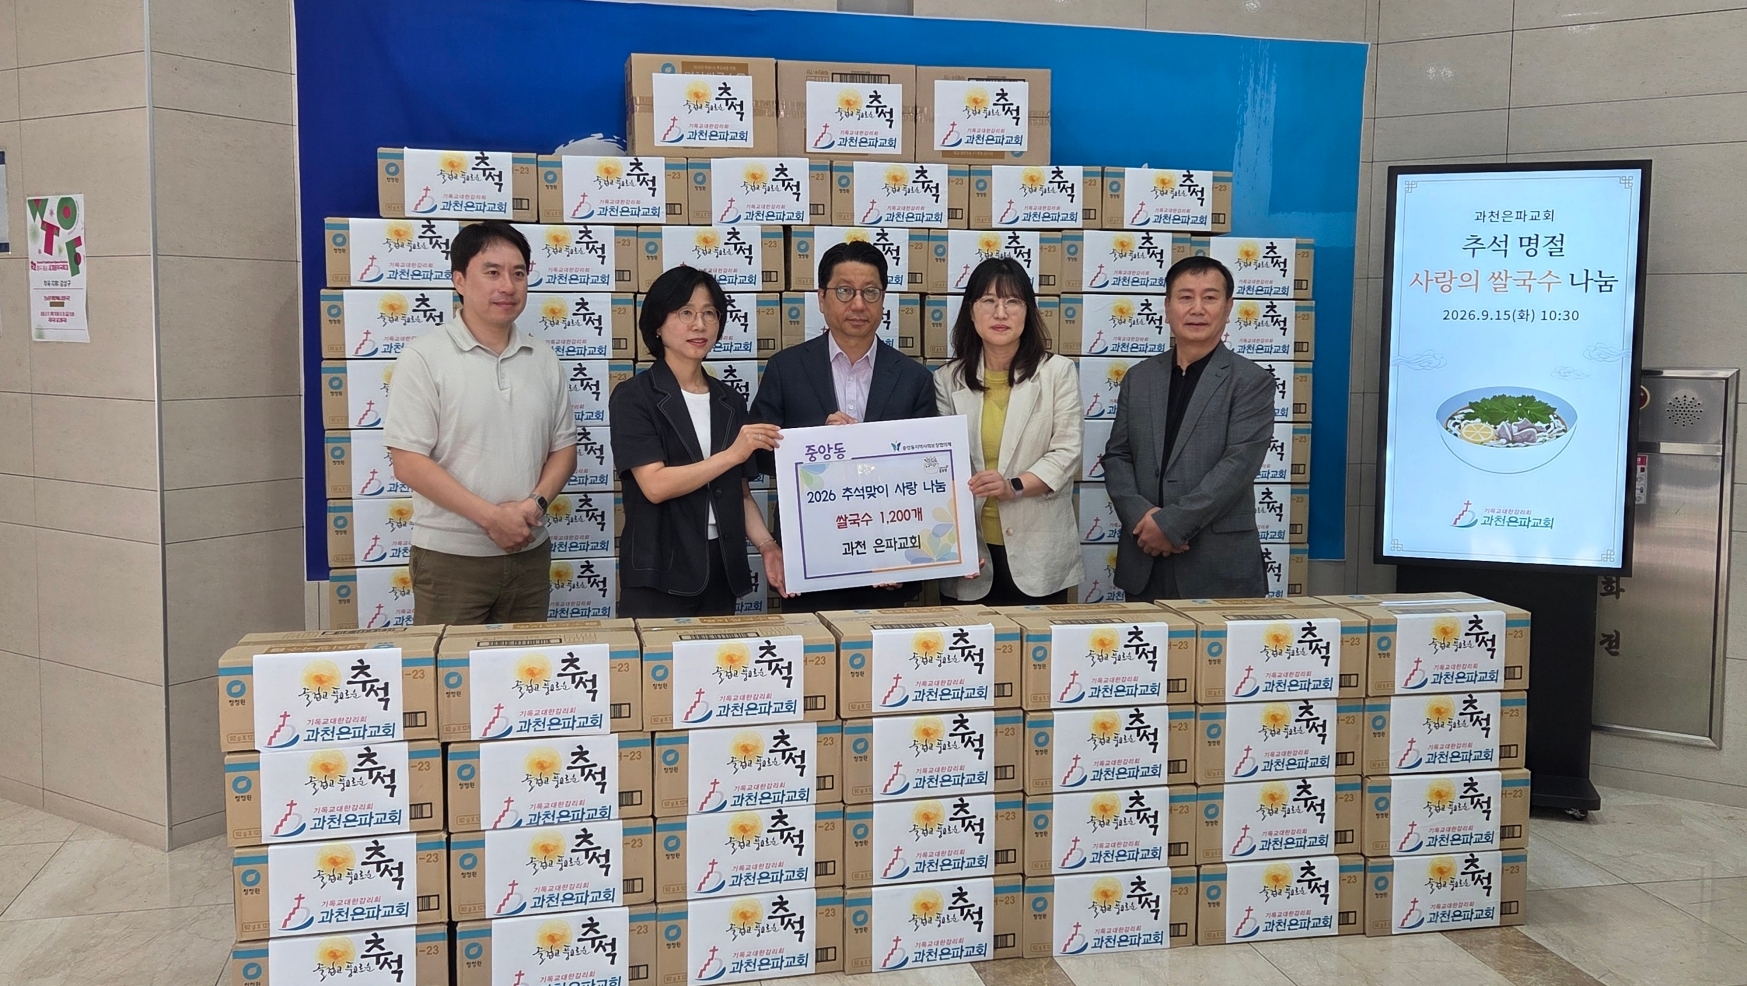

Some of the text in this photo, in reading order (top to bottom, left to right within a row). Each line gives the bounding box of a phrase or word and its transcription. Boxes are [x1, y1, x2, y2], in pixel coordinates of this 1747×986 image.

[716, 82, 744, 121] 추석
[866, 90, 893, 128] 추석
[993, 88, 1020, 126] 추석
[686, 131, 748, 142] 과천은파교회
[837, 138, 896, 148] 과천은파교회
[964, 135, 1022, 145] 과천은파교회
[472, 154, 503, 192] 추석
[627, 158, 656, 197] 추석
[772, 163, 800, 201] 추석
[913, 166, 939, 203] 추석
[1049, 168, 1074, 202] 추석
[1179, 172, 1204, 206] 추석
[440, 200, 507, 211] 과천은파교회
[597, 205, 660, 216] 과천은파교회
[744, 210, 804, 220] 과천은파교회
[1474, 209, 1555, 223] 과천은파교회
[884, 211, 942, 222] 과천은파교회
[1021, 211, 1077, 222] 과천은파교회
[1152, 213, 1207, 223] 과천은파교회
[418, 220, 450, 260] 추석
[576, 228, 605, 264] 추석
[1139, 234, 1163, 267] 추석
[1462, 233, 1565, 258] 추석 명절
[1263, 242, 1287, 277] 추석
[545, 272, 609, 284] 과천은파교회
[1110, 275, 1164, 286] 과천은파교회
[1409, 269, 1619, 293] 사랑의 쌀국수 나눔
[1237, 286, 1288, 295] 과천은파교회
[572, 298, 602, 336] 추석
[1138, 299, 1162, 334] 추석
[1263, 301, 1287, 336] 추석
[1443, 309, 1579, 323] 2026.9.15(화) 10:30
[551, 345, 607, 356] 천은파교회
[1110, 342, 1164, 351] 과천은파교회
[1236, 343, 1289, 353] 과천은파교회
[570, 363, 600, 401] 추석
[805, 442, 846, 462] 중앙동
[807, 480, 946, 503] 2026 추석맞이 사랑 나눔
[576, 494, 606, 531] 추석
[1259, 488, 1283, 522] 추석
[836, 507, 923, 529] 쌀국수 1,200개
[1480, 516, 1554, 529] 과천은파교회
[842, 535, 921, 556] 과천 은파교회
[577, 560, 607, 597] 추석
[548, 606, 610, 618] 과천은파교회
[1298, 622, 1330, 666] 추석
[1465, 615, 1496, 659] 추석
[949, 629, 984, 674] 추석
[1124, 626, 1157, 671] 추석
[755, 640, 792, 688] 추석
[347, 659, 390, 710] 추석
[557, 652, 597, 701] 추석
[1262, 677, 1333, 693] 과천은파교회
[1430, 669, 1498, 685] 과천은파교회
[719, 693, 772, 702] 기독교대한감리회
[912, 685, 987, 703] 과천은파교회
[1088, 682, 1160, 699] 과천은파교회
[520, 707, 576, 716] 기독교대한감리회
[716, 698, 796, 718] 과천은파교회
[1459, 694, 1490, 738] 추석
[307, 716, 367, 725] 기독교대한감리회
[516, 714, 602, 733] 과천은파교회
[1125, 708, 1158, 753] 추석
[1295, 698, 1327, 744] 추석
[303, 723, 395, 742] 과천은파교회
[949, 714, 984, 760] 추석
[769, 729, 805, 776] 추석
[1425, 749, 1493, 764] 과천은파교회
[353, 747, 396, 797] 추석
[567, 745, 606, 793] 추석
[1090, 764, 1161, 781] 과천은파교회
[1261, 755, 1329, 772] 과천은파교회
[734, 782, 785, 791] 기독교대한감리회
[912, 769, 988, 790] 과천은파교회
[529, 800, 585, 810] 기독교대한감리회
[730, 787, 809, 807] 과천은파교회
[1293, 775, 1325, 823] 추석
[1460, 777, 1491, 821] 추석
[313, 803, 373, 813] 기독교대한감리회
[526, 804, 612, 826] 과천은파교회
[1125, 790, 1158, 836] 추석
[310, 810, 402, 830] 과천은파교회
[949, 797, 984, 844] 추석
[767, 809, 804, 856] 추석
[1259, 834, 1328, 851] 과천은파교회
[1425, 831, 1494, 848] 과천은파교회
[571, 828, 610, 876] 추석
[1089, 847, 1161, 864] 과천은파교회
[361, 840, 404, 890] 추석
[732, 861, 784, 871] 기독교대한감리회
[912, 855, 988, 873] 과천은파교회
[1461, 853, 1492, 896] 추석
[533, 882, 589, 892] 기독교대한감리회
[728, 867, 808, 887] 과천은파교회
[1297, 861, 1329, 905] 추석
[321, 895, 381, 908] 기독교대한감리회
[530, 888, 615, 909] 과천은파교회
[1127, 876, 1160, 920] 추석
[318, 900, 409, 925] 과천은파교회
[768, 895, 804, 942] 추석
[948, 886, 983, 932] 추석
[1427, 907, 1494, 924] 과천은파교회
[1262, 914, 1332, 933] 과천은파교회
[577, 917, 616, 965] 추석
[1091, 931, 1163, 950] 과천은파교회
[361, 932, 403, 982] 추석
[729, 953, 808, 974] 과천은파교회
[912, 943, 987, 963] 과천은파교회
[540, 971, 595, 982] 기독교대한감리회
